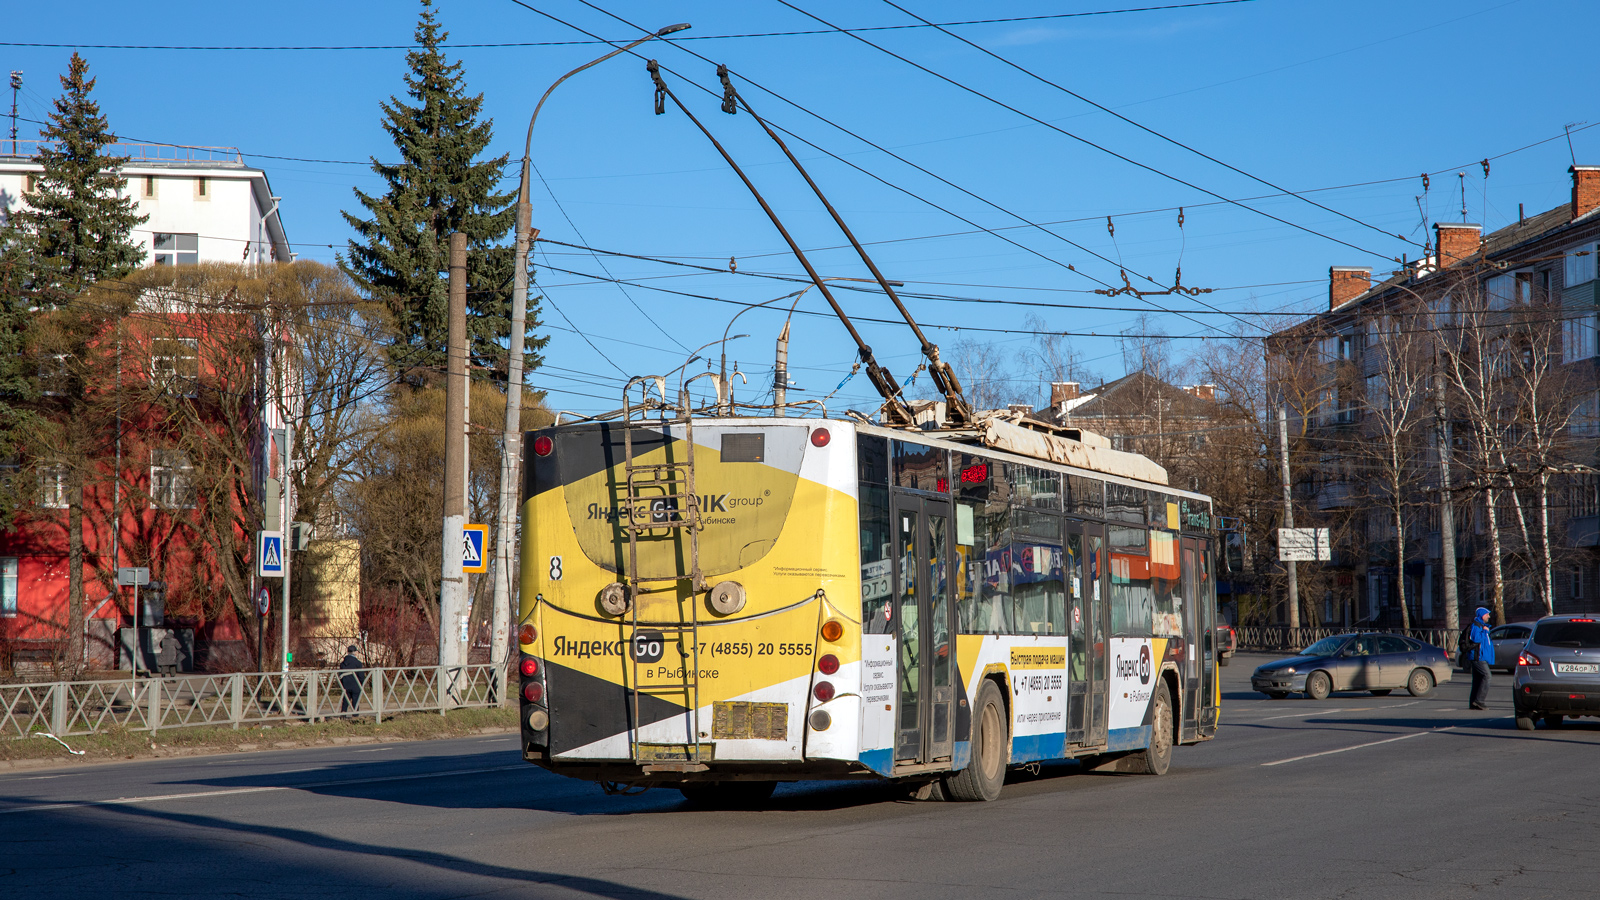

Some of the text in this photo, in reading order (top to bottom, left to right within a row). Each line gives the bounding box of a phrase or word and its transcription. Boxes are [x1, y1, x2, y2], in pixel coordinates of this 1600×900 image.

[729, 497, 764, 509] group
[549, 556, 563, 581] 8
[260, 596, 268, 608] 40
[553, 636, 624, 659] Яндекс
[636, 635, 661, 657] Go
[711, 642, 754, 658] (4855)
[757, 642, 774, 656] 20
[778, 643, 813, 656] 5555
[1010, 651, 1065, 668] Быстрая подача машин
[1116, 653, 1139, 681] Яндекс
[1140, 652, 1150, 677] Go
[646, 666, 719, 679] в Рыбинске
[1021, 675, 1062, 695] +7 (4855) 20 5555
[1017, 711, 1061, 725] или через приложение
